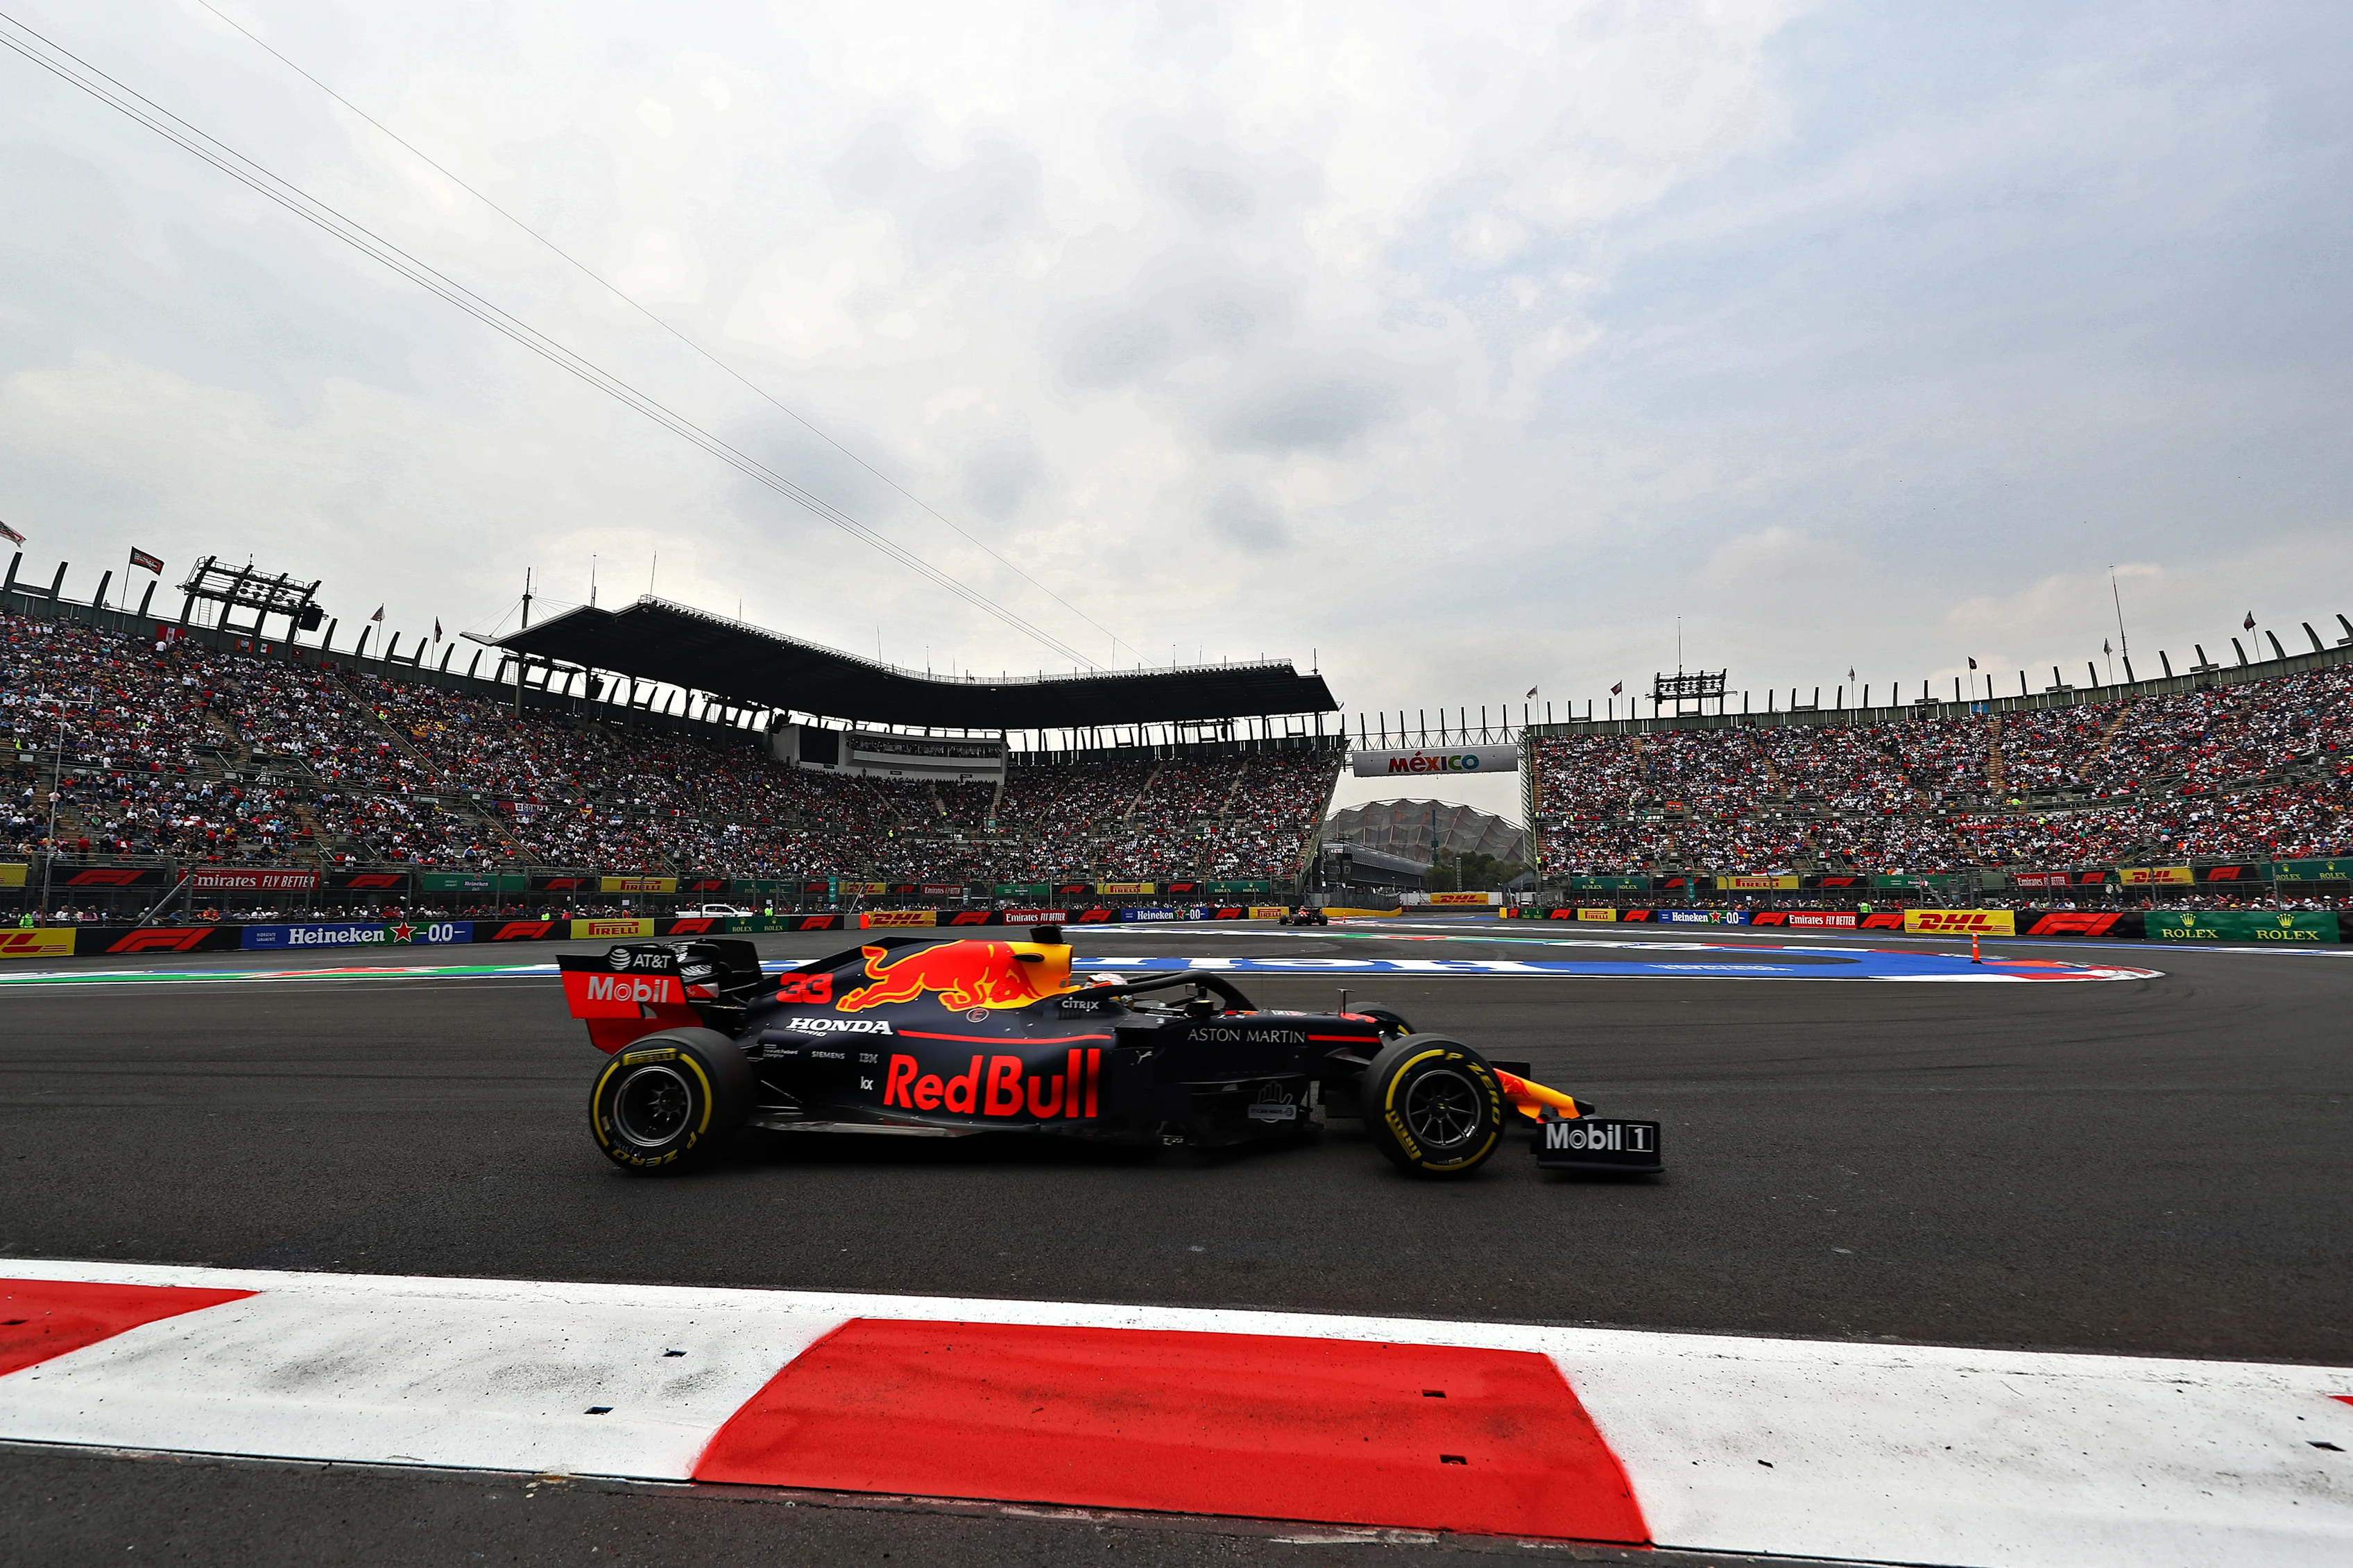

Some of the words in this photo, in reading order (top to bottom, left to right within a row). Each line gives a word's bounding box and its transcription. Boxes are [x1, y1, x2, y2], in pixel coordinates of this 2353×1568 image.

[262, 875, 279, 888] FLY
[2132, 870, 2175, 883] DHL
[2319, 872, 2347, 880] ROLEX
[620, 880, 662, 891] PIRELLI
[1736, 878, 1779, 888] PIRELLI
[1440, 895, 1479, 903] DHL
[1006, 912, 1038, 922] Emirates
[1049, 912, 1066, 922] BETTER
[1137, 911, 1174, 920] Heineken
[1258, 908, 1282, 917] PIRELLI
[1584, 911, 1609, 920] PIRELLI
[1672, 911, 1709, 922] Heineken
[872, 913, 925, 925] DHL
[1789, 914, 1824, 925] Emirates
[1826, 915, 1836, 925] FLY
[1836, 915, 1856, 926] BETTER
[1918, 913, 1994, 932] DHL
[589, 921, 640, 936] PIRELLI
[2162, 929, 2219, 938] ROLEX
[2256, 929, 2320, 940] ROLEX
[288, 928, 386, 945] Heineken
[633, 954, 672, 969] AT&T
[588, 976, 669, 1003] Mobil
[776, 972, 835, 1004] 33
[785, 1017, 894, 1035] HONDA
[1188, 1028, 1241, 1042] ASTON
[1246, 1029, 1306, 1043] MARTIN
[812, 1051, 846, 1060] SIEMENS
[859, 1053, 879, 1064] IBM
[1444, 1052, 1465, 1060] P
[1466, 1061, 1501, 1126] ZERO
[687, 1131, 698, 1149] P
[1546, 1123, 1622, 1151] Mobil
[612, 1148, 678, 1167] ZERO
